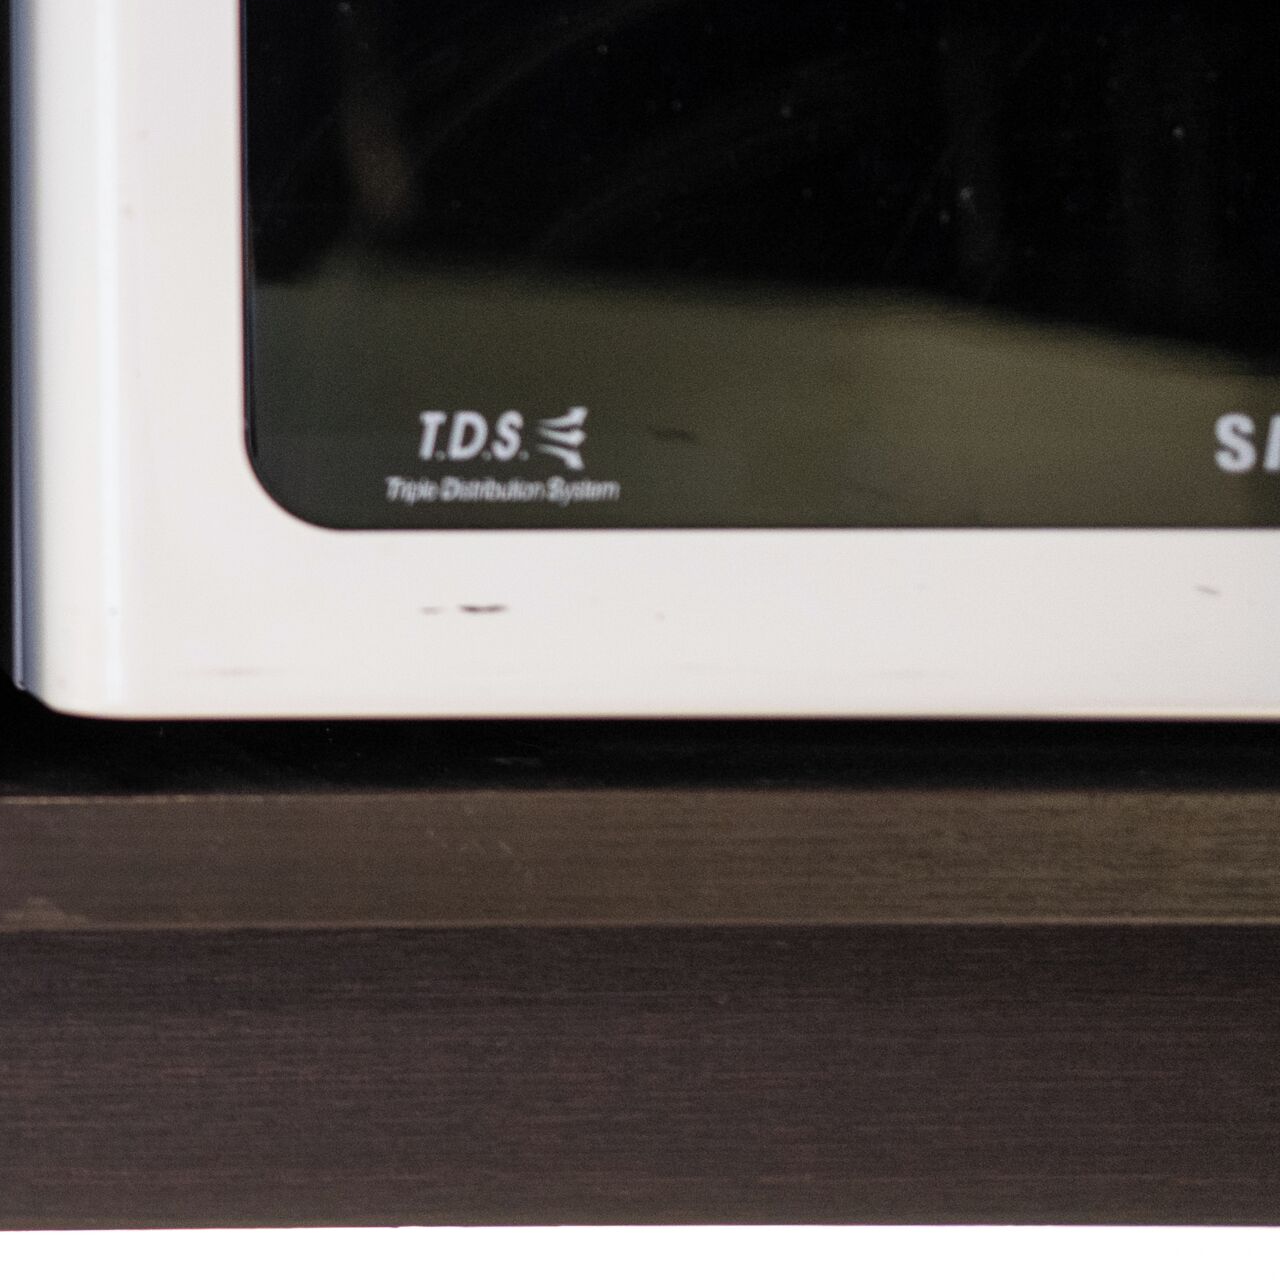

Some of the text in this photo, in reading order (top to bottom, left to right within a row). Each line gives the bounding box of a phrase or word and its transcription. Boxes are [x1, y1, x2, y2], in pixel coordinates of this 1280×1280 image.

[386, 475, 621, 506] Triple Distribution System
